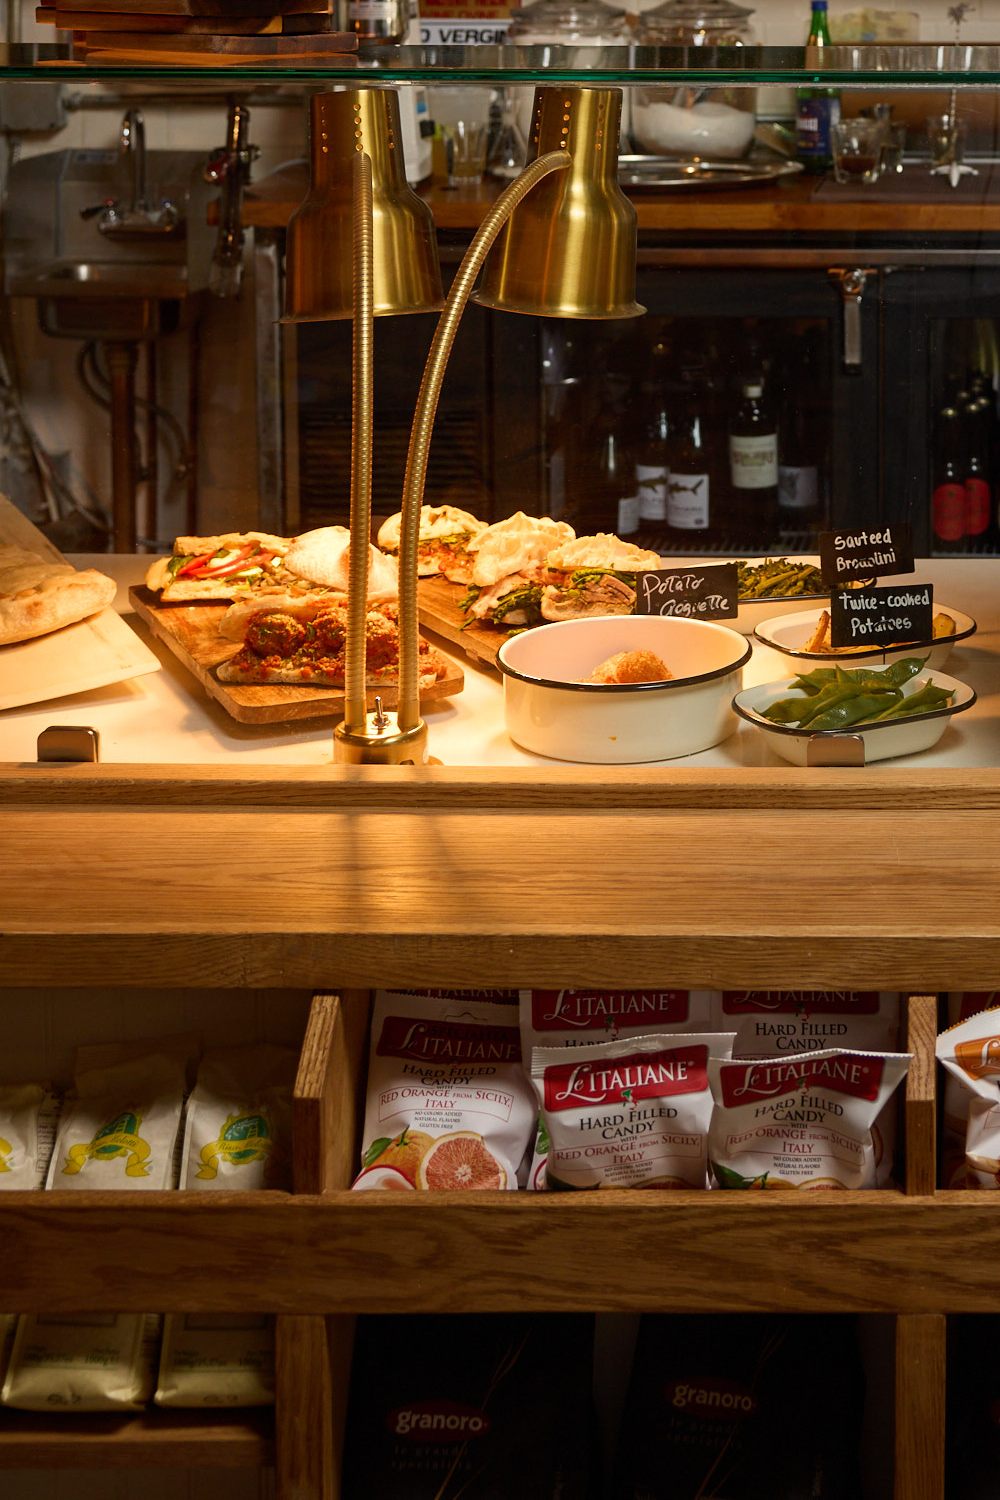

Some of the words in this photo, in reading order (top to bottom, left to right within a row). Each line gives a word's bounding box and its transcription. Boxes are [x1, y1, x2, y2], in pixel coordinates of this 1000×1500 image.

[834, 528, 892, 551] Sauteed
[643, 574, 705, 612] Potato
[755, 1022, 796, 1035] HARD
[801, 1022, 848, 1035] FILLED
[776, 1036, 826, 1050] CANDY
[402, 1064, 445, 1077] HARD
[450, 1064, 496, 1077] FILLED
[421, 1077, 473, 1085] CANDY
[556, 1064, 606, 1102] Le
[589, 1061, 688, 1092] ITALIANE
[425, 1099, 456, 1108] ITALY
[755, 1098, 795, 1118] HARD
[801, 1095, 843, 1116] FILLED
[580, 1115, 624, 1131] HARD
[629, 1108, 678, 1123] FILLED
[773, 1110, 826, 1122] CANDY
[602, 1121, 656, 1140] CANDY
[782, 1141, 815, 1153] ITALY
[613, 1151, 645, 1164] ITALY
[673, 1388, 752, 1412] granoro
[395, 1410, 480, 1434] granoro
